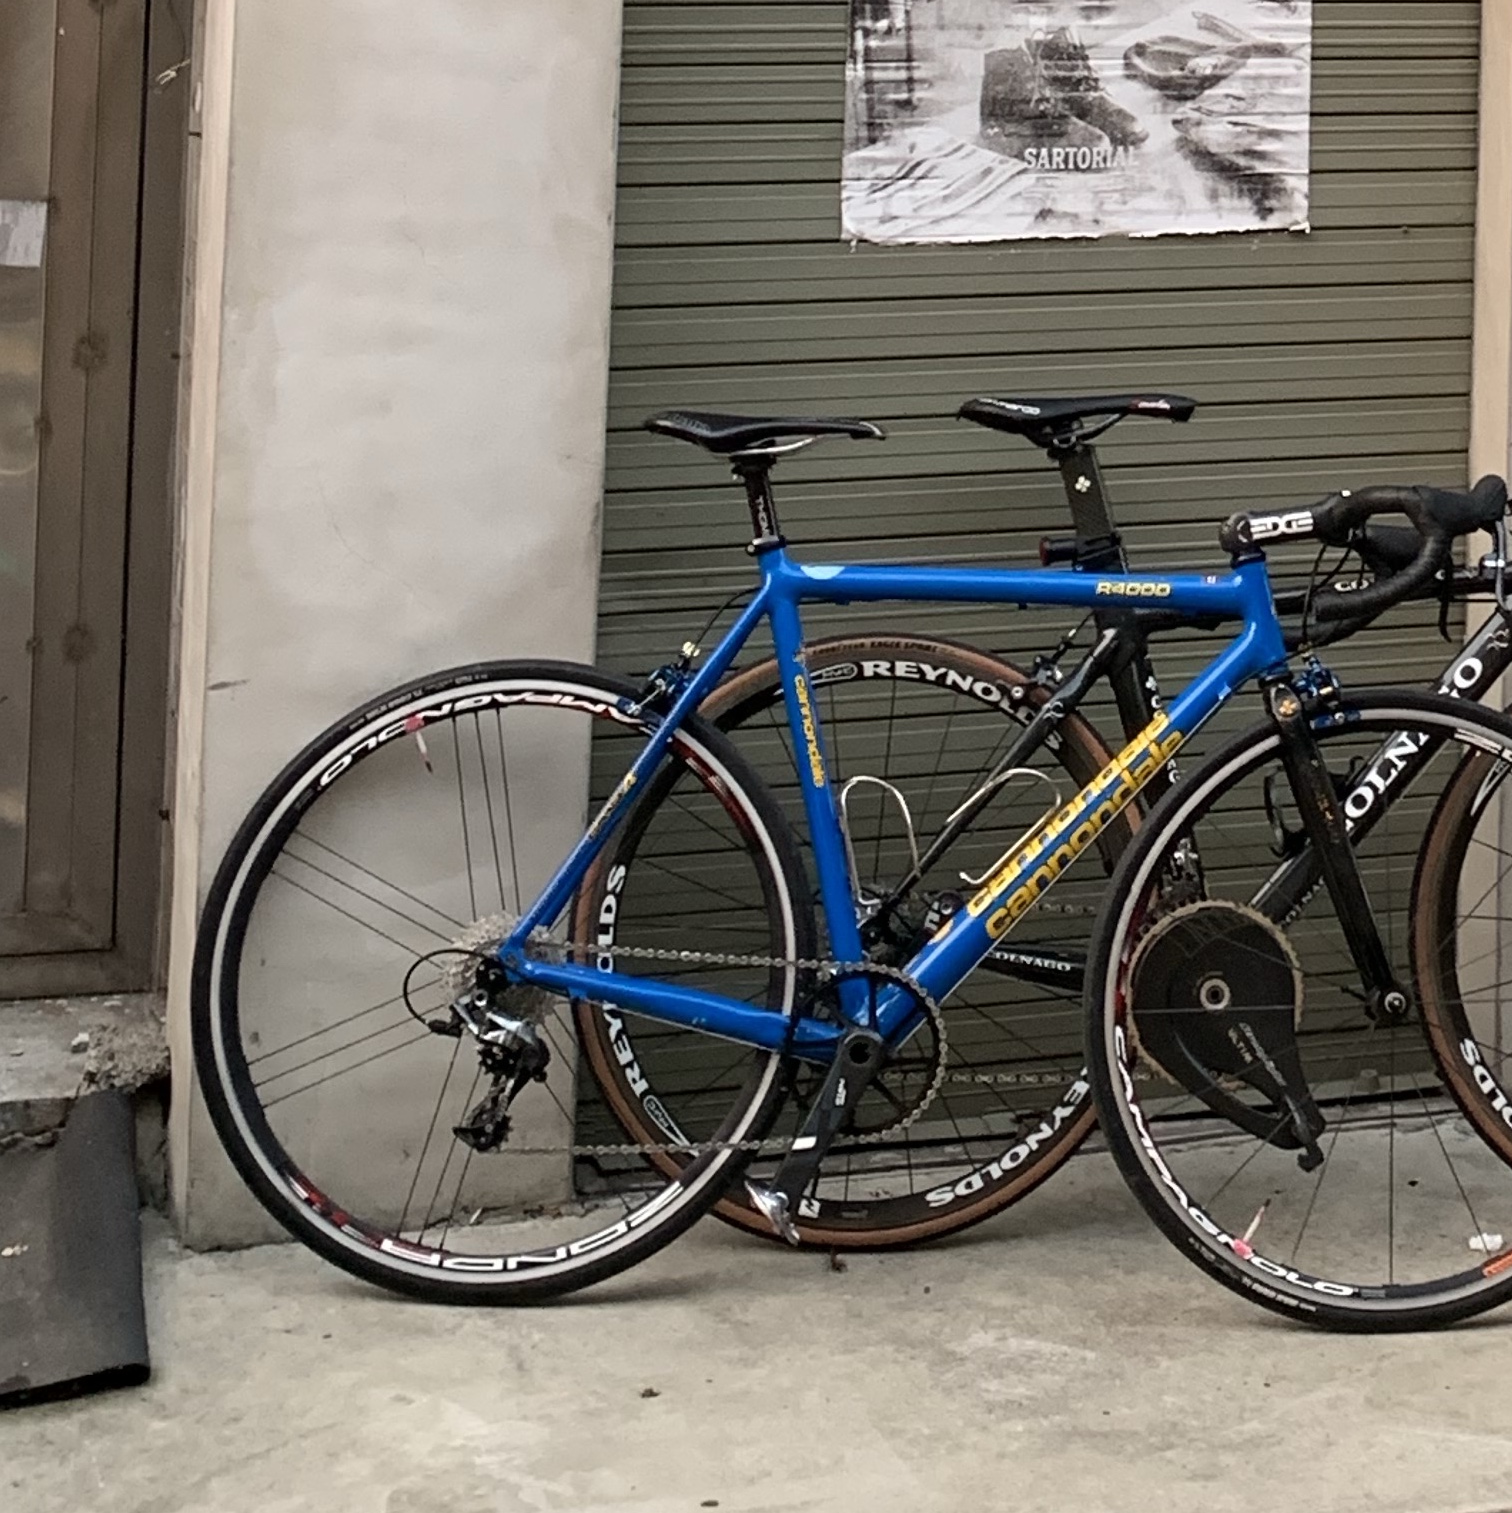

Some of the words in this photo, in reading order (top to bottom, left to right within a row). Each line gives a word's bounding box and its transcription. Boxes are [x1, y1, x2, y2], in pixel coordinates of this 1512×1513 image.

[1023, 145, 1140, 170] SARTORIAL
[1095, 581, 1171, 597] R4000
[966, 709, 1170, 918] cannondale
[597, 864, 649, 1099] REYOLDS
[924, 1067, 1090, 1208] EYNOLDS
